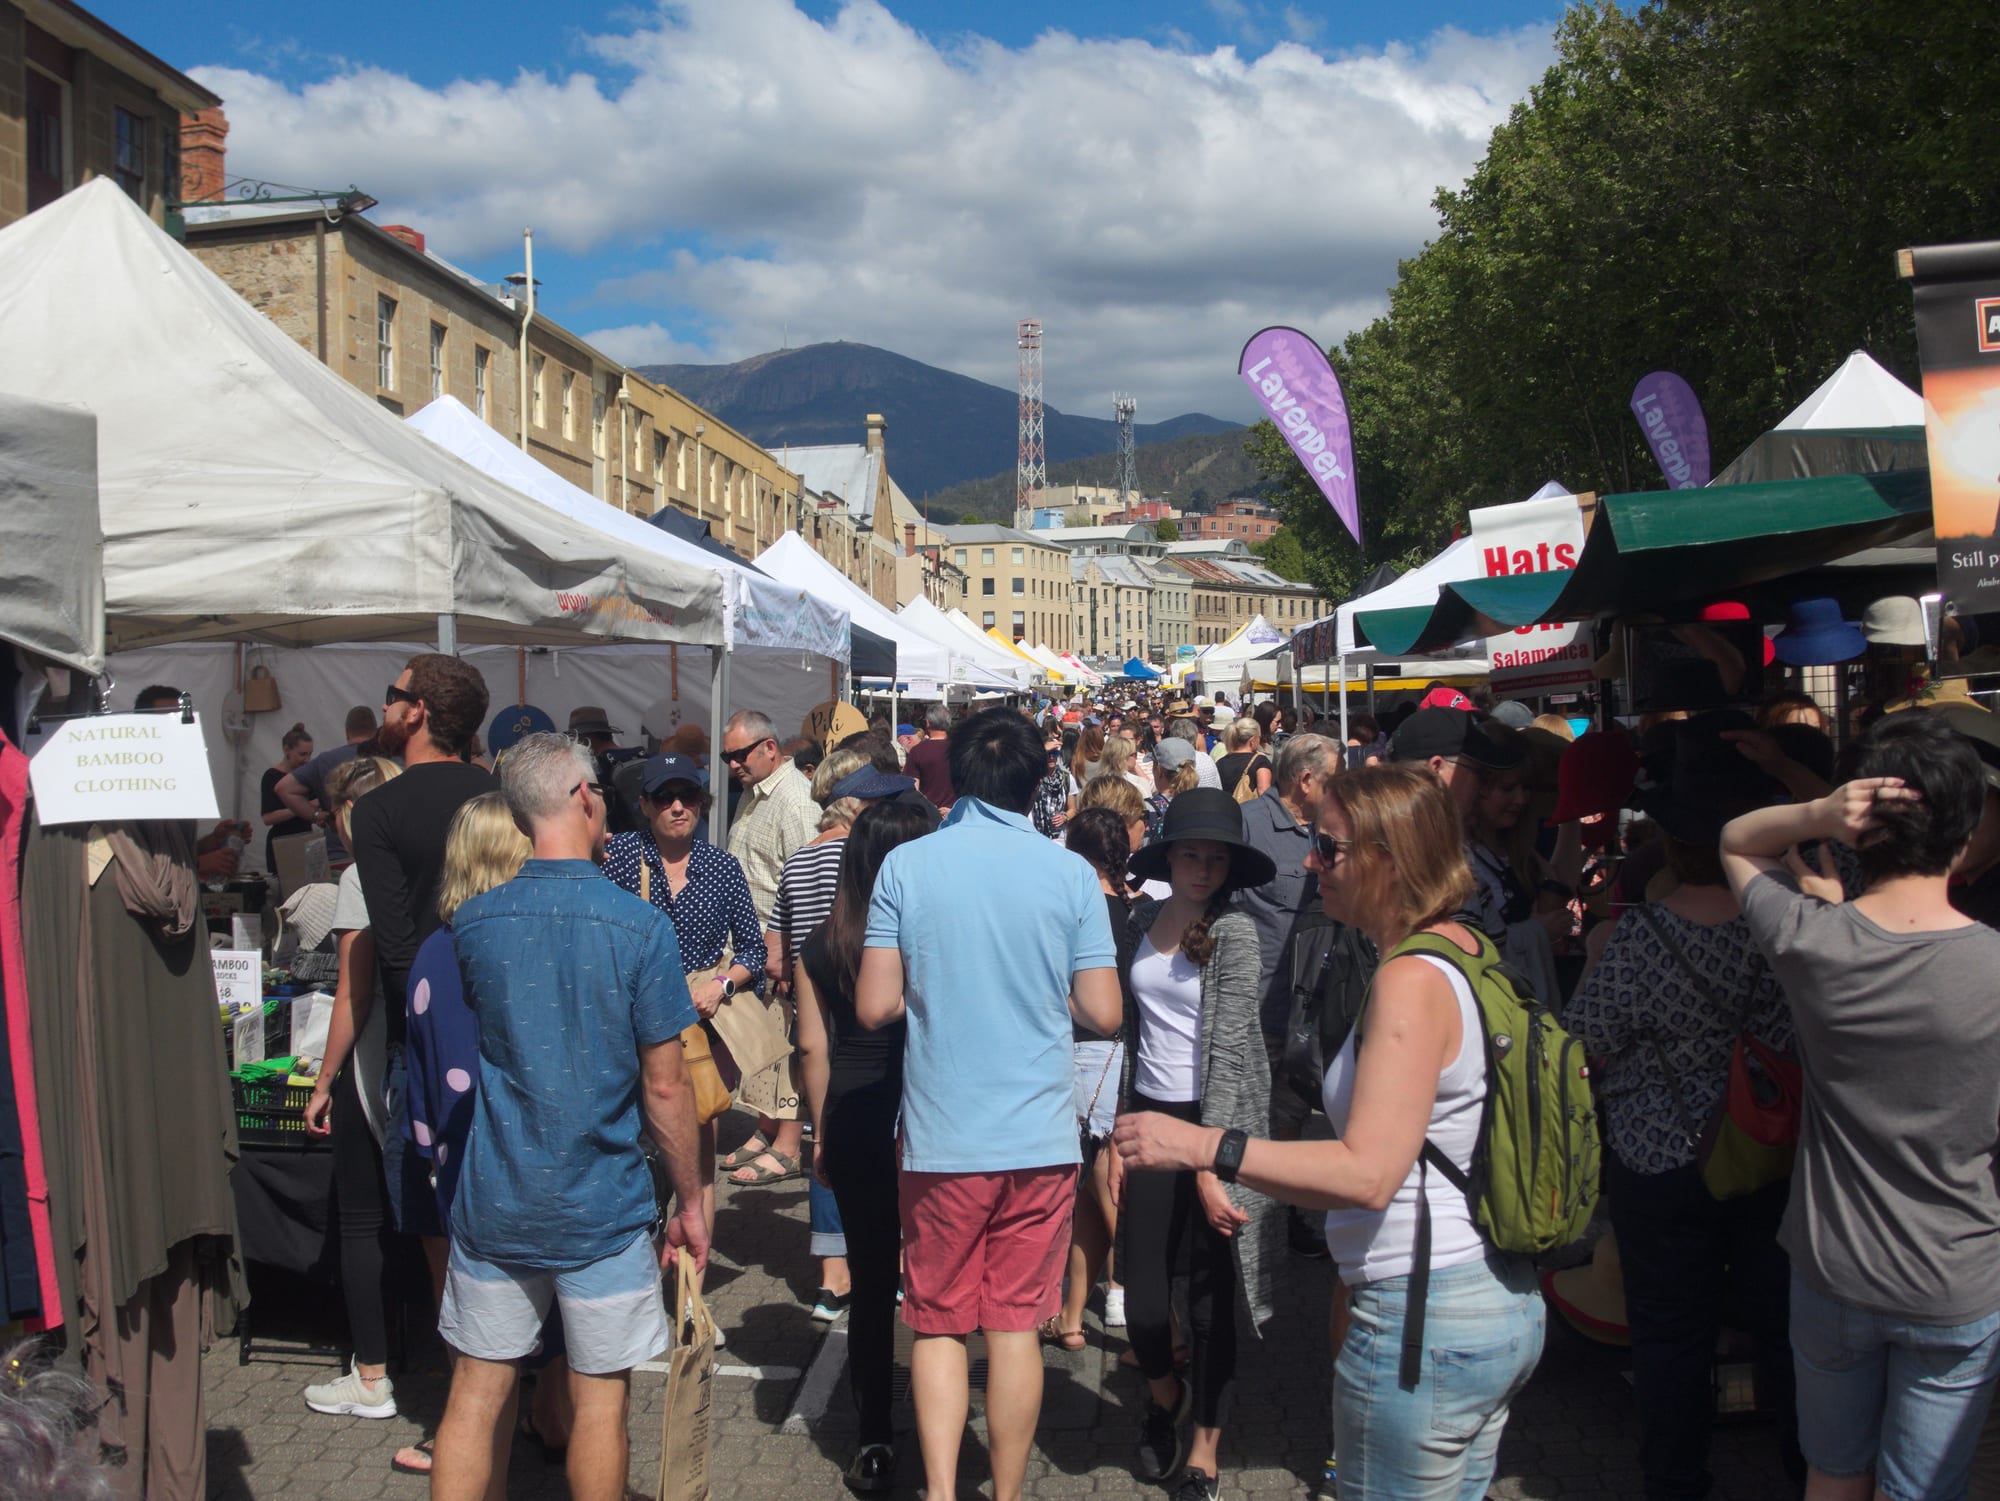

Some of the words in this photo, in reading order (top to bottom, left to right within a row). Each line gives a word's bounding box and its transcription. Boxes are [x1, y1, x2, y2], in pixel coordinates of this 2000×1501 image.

[1987, 315, 2000, 334] A
[1483, 542, 1577, 577] Hats
[1952, 550, 1984, 569] Still
[1989, 554, 2000, 568] p
[1492, 642, 1590, 670] Salamanca
[67, 726, 162, 743] NATURAL
[76, 751, 164, 768] BAMBOO
[74, 778, 177, 793] CLOTHING
[211, 959, 249, 970] AMBOO
[216, 972, 237, 980] SOCKS
